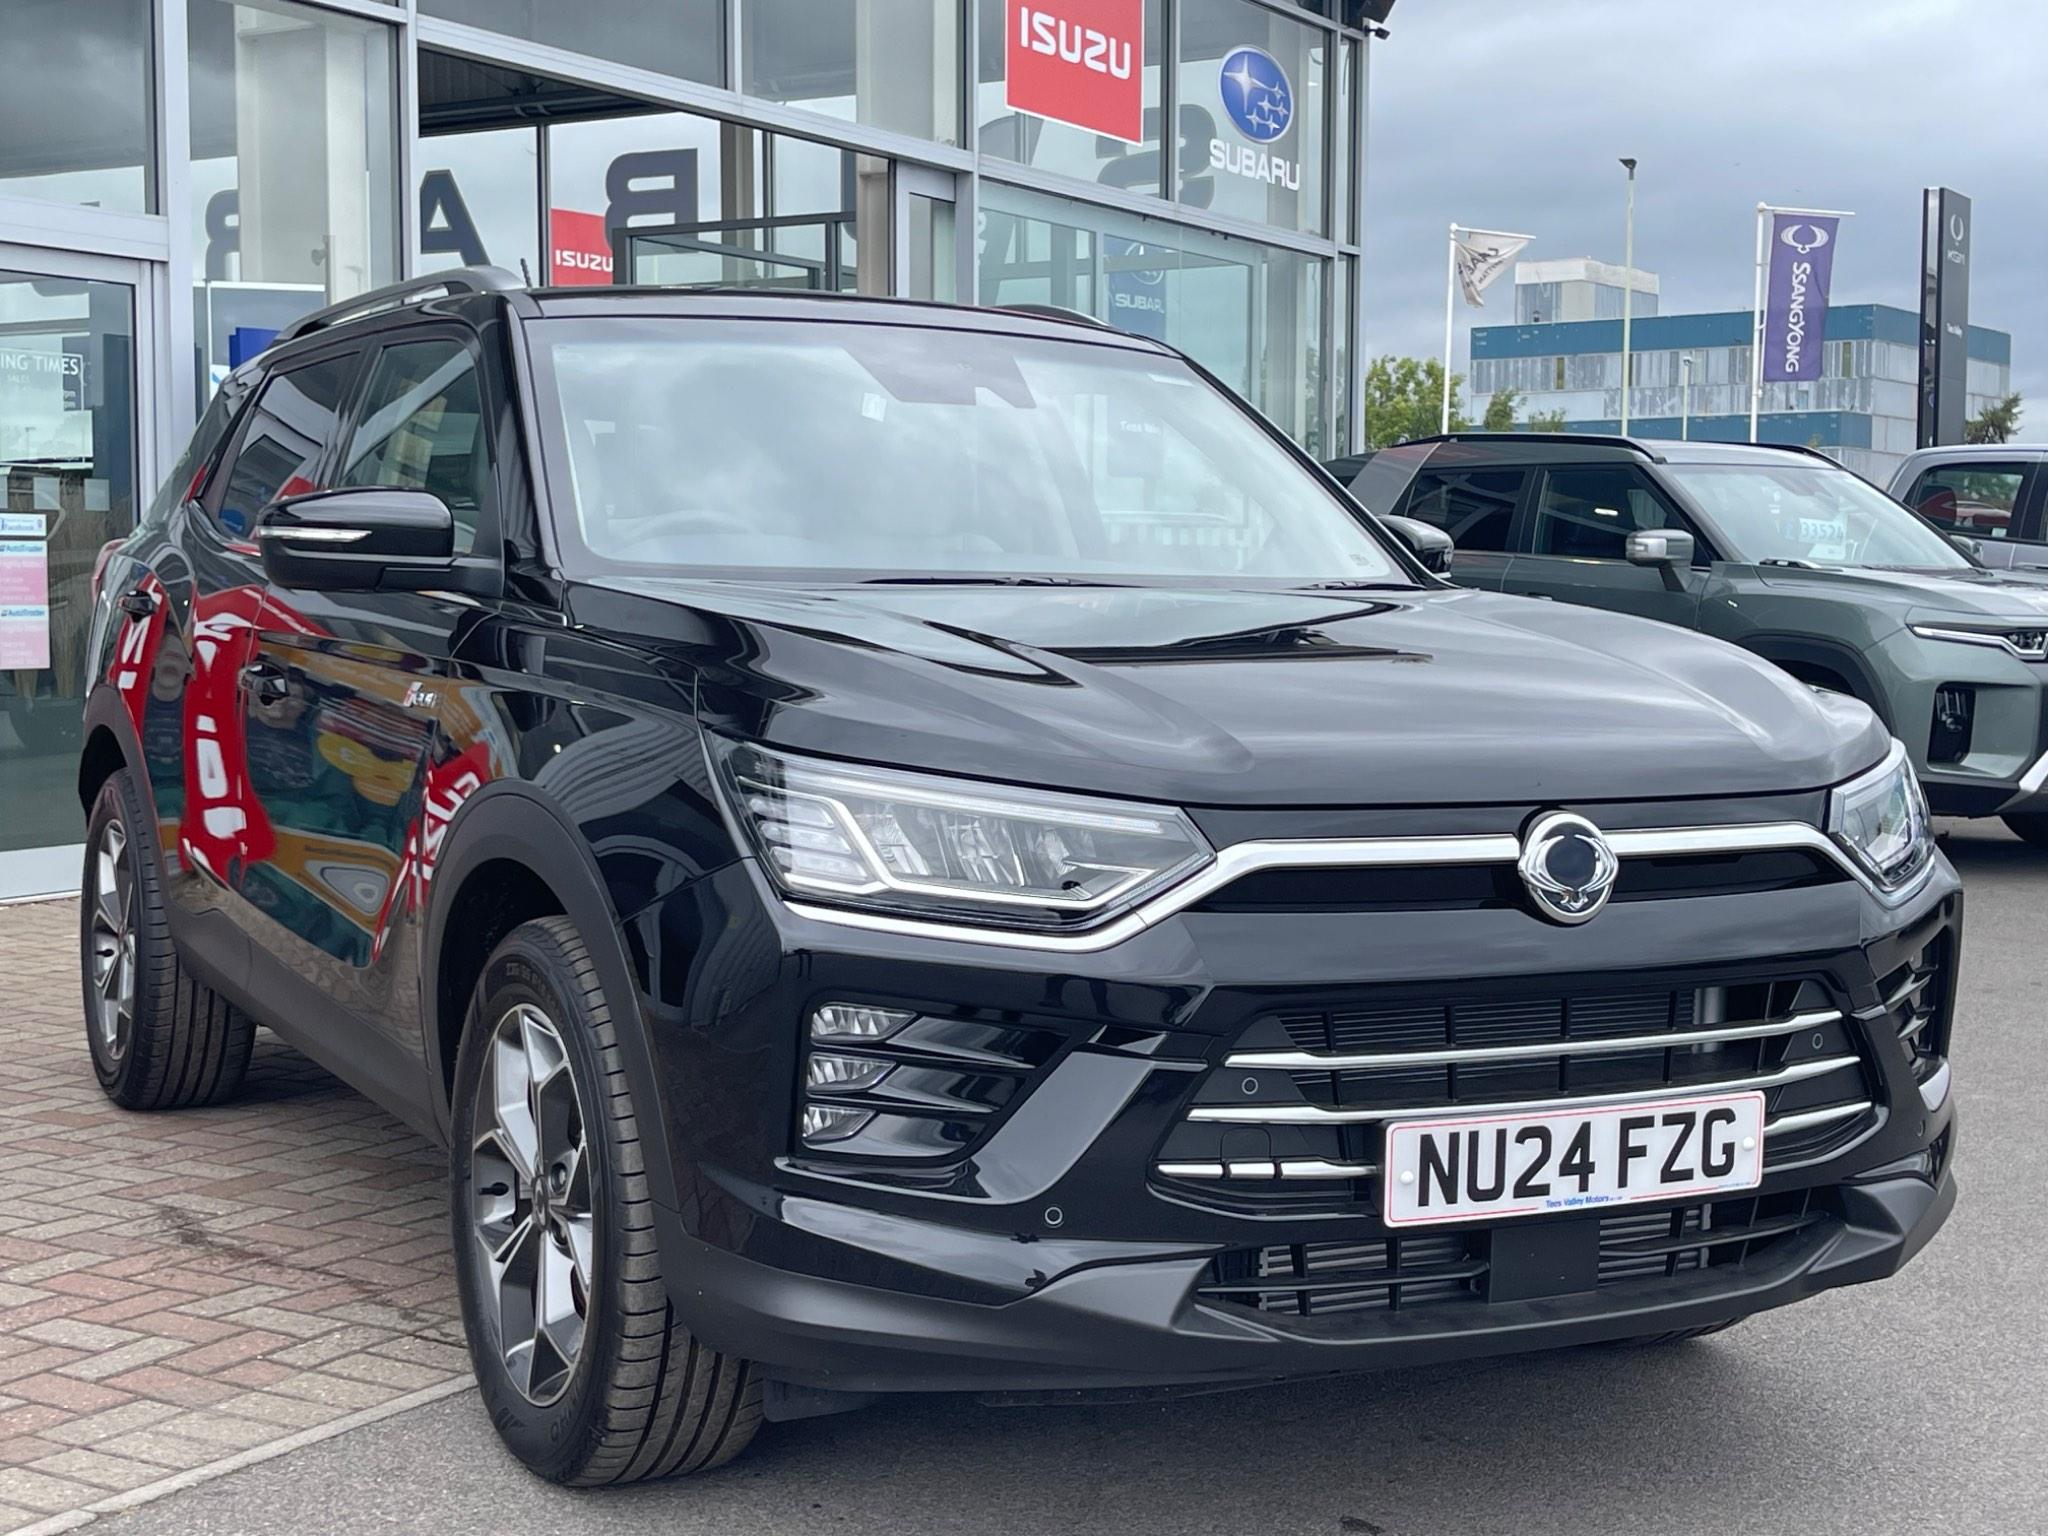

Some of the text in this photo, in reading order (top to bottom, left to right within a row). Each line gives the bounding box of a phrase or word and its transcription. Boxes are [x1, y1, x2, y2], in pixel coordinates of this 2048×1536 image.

[1020, 7, 1131, 80] ISUZU
[1209, 138, 1300, 190] SUBARU
[555, 249, 613, 273] ISUZU
[1785, 261, 1811, 374] SSANGYONG
[33, 355, 79, 376] TIMES
[1417, 1106, 1737, 1208] NU24 FZG
